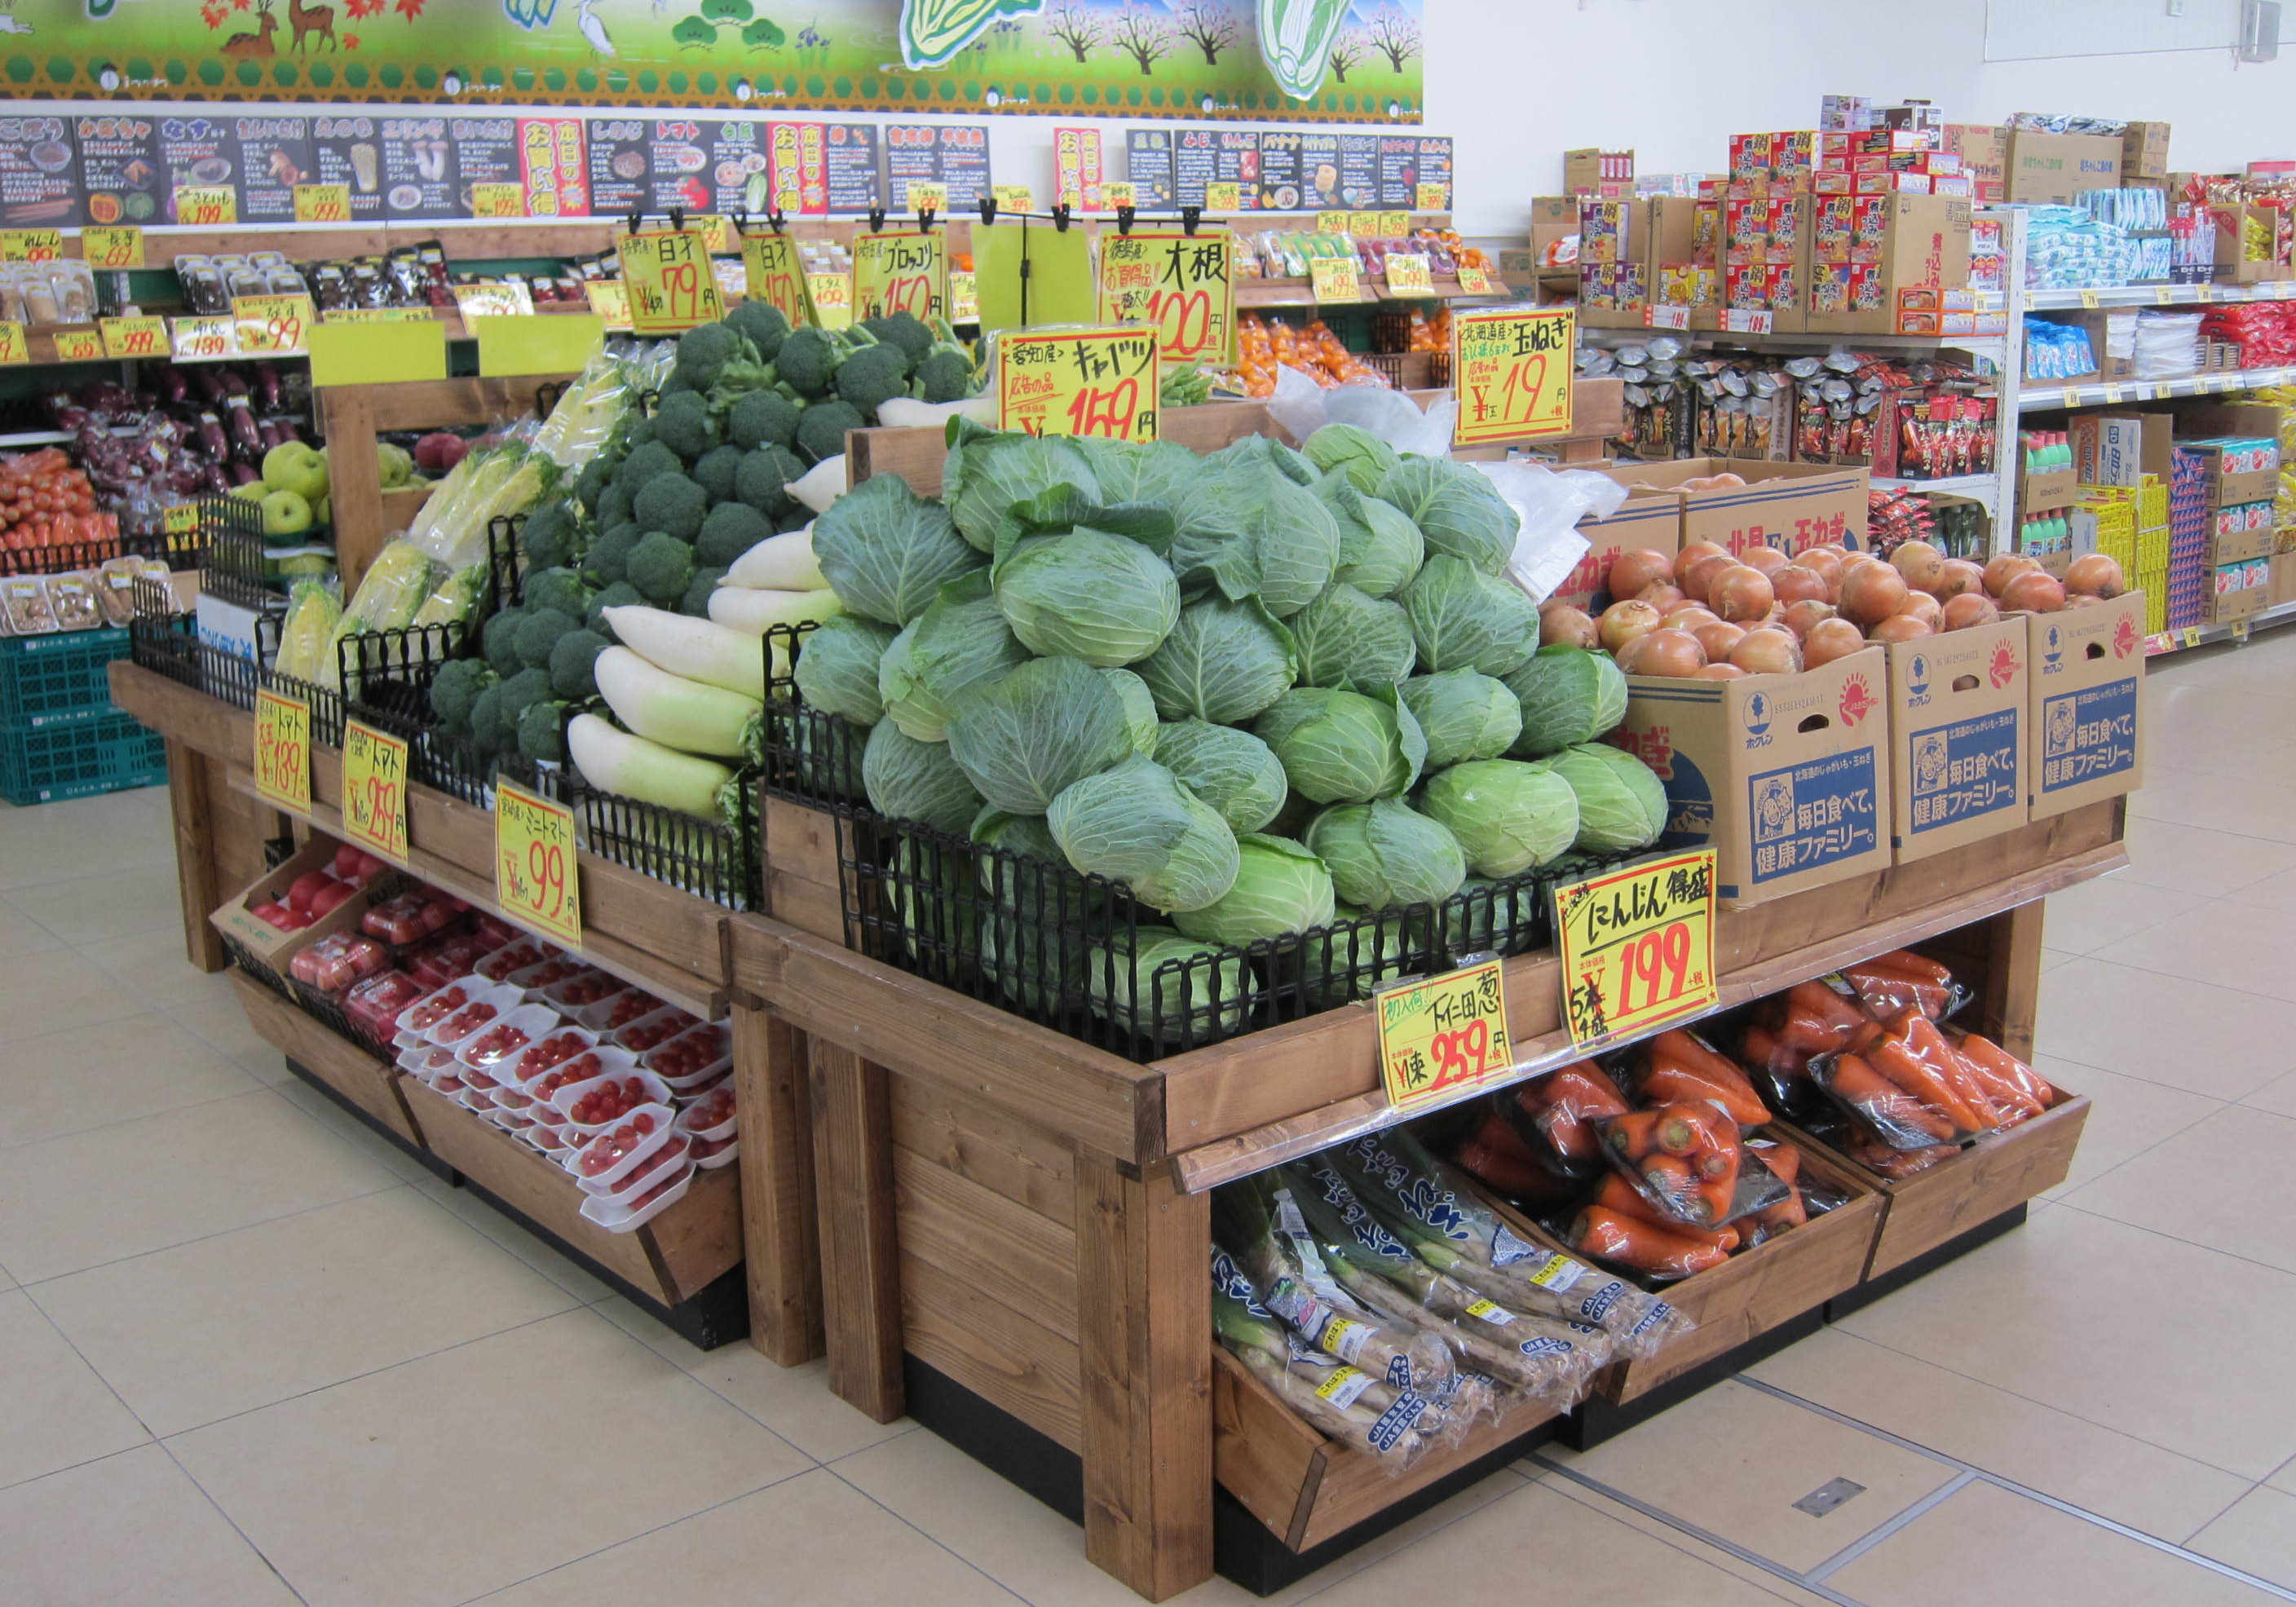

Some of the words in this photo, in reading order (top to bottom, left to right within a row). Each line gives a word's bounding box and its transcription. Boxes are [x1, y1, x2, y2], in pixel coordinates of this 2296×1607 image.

[555, 122, 580, 179] 本日の
[656, 120, 701, 140] トマト
[801, 126, 822, 180] 本日の
[1082, 130, 1098, 180] 本日の
[527, 121, 556, 216] お買い得
[774, 125, 800, 212] お買い得
[1059, 130, 1083, 210] お買い得
[661, 261, 697, 321] 79
[1161, 241, 1229, 292] 大根
[124, 330, 154, 354] 299
[267, 317, 301, 350] 99
[1145, 289, 1212, 356] 100
[1512, 311, 1574, 358] 玉ねぎ
[1072, 338, 1155, 383] キャベツ
[1501, 353, 1548, 422] 19
[1066, 377, 1139, 439] 159
[277, 705, 304, 740] トマト
[1908, 694, 1932, 709] ホクレン
[273, 739, 301, 798] 139
[372, 737, 399, 779] トマト
[1745, 734, 1774, 750] ホクレン
[367, 775, 396, 854] 259
[525, 806, 567, 845] ミニトマト
[528, 839, 565, 920] 99
[1587, 875, 1668, 946] にんじん
[1578, 954, 1606, 971] 本体価格
[1615, 921, 1691, 1018] 199
[1687, 969, 1704, 987] +税
[1430, 1018, 1488, 1093] 259
